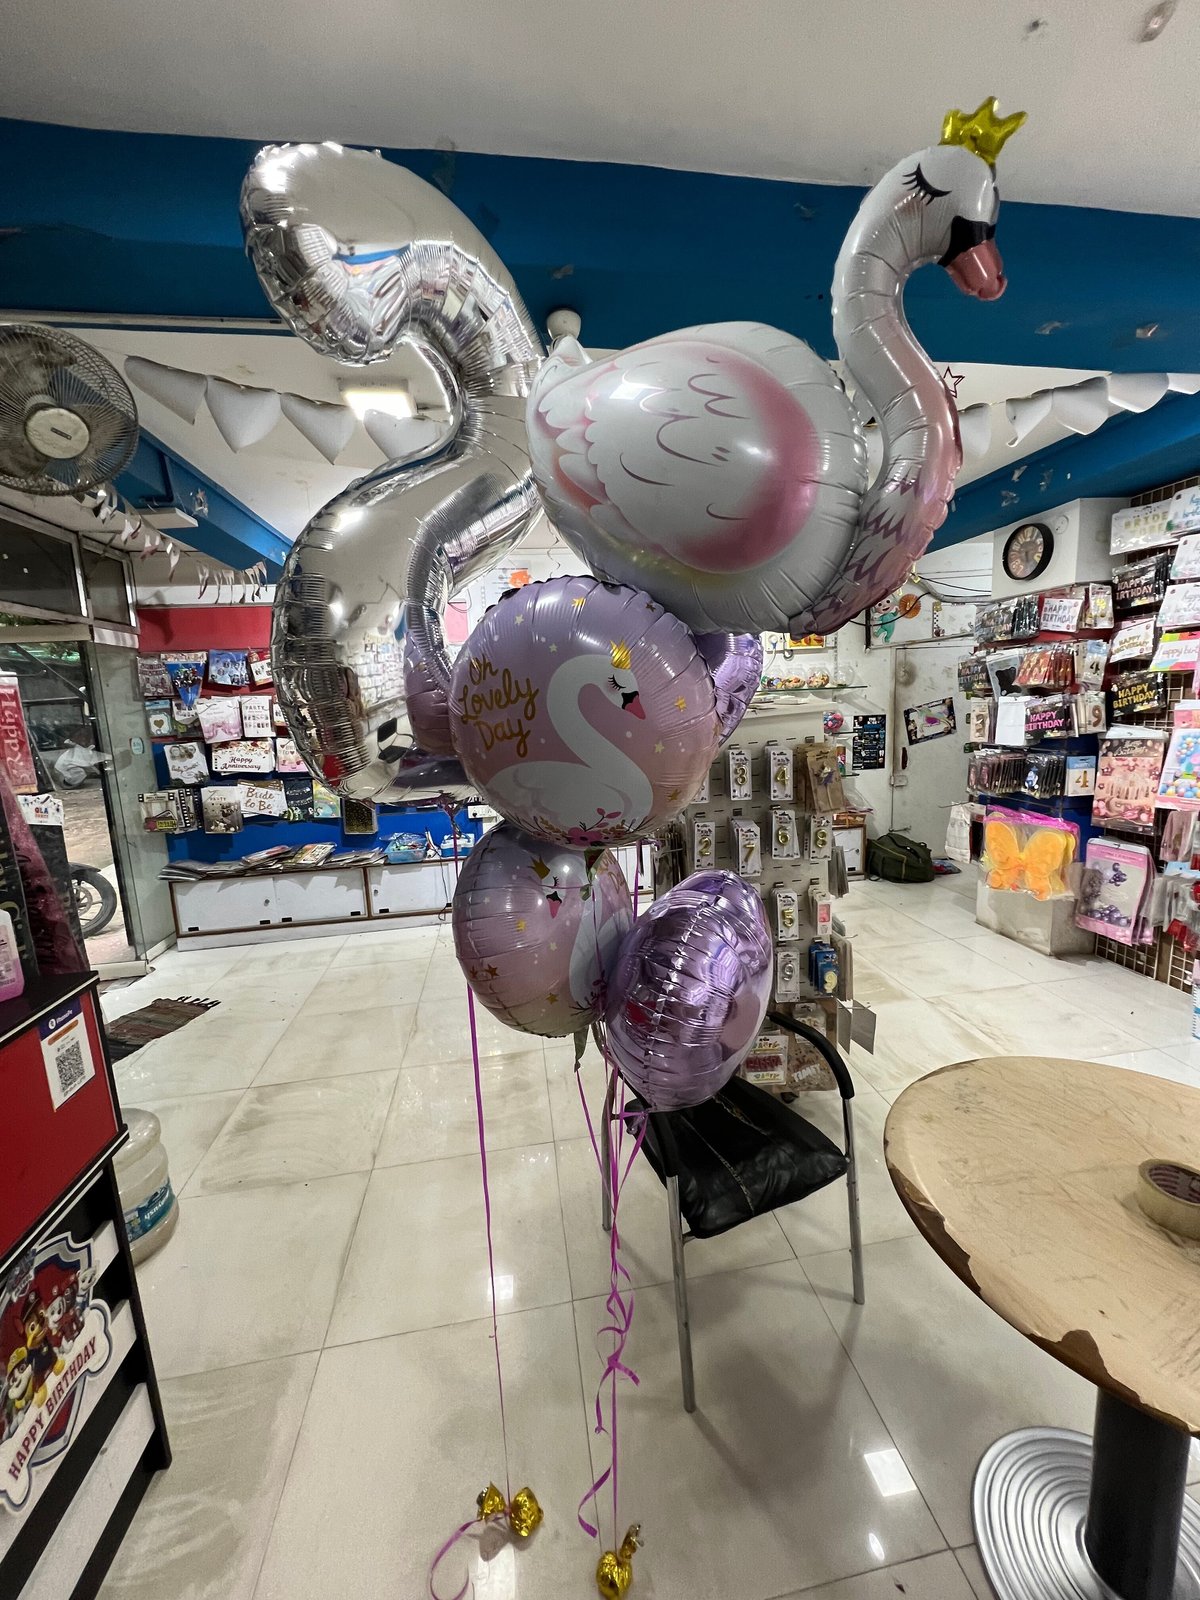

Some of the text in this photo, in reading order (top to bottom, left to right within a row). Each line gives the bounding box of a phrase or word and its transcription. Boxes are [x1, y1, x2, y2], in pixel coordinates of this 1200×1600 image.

[469, 653, 498, 685] Oh
[459, 667, 540, 724] Lovely
[1112, 690, 1156, 709] BIRTHDAY
[1117, 683, 1149, 699] HAPPY
[1030, 711, 1057, 722] HAPPY
[1092, 705, 1102, 727] 9
[475, 717, 531, 758] Day
[229, 756, 253, 765] Happy
[734, 766, 748, 786] 3
[775, 765, 789, 785] 4
[246, 787, 275, 800] Bride
[244, 801, 272, 811] to Be
[777, 825, 791, 846] 6
[816, 828, 828, 849] 8
[698, 837, 712, 857] 2
[743, 843, 756, 863] 7
[782, 907, 795, 928] 5
[783, 963, 796, 982] 9
[823, 970, 838, 994] 9
[8, 1335, 97, 1480] HAPPY BIRTHDAY
